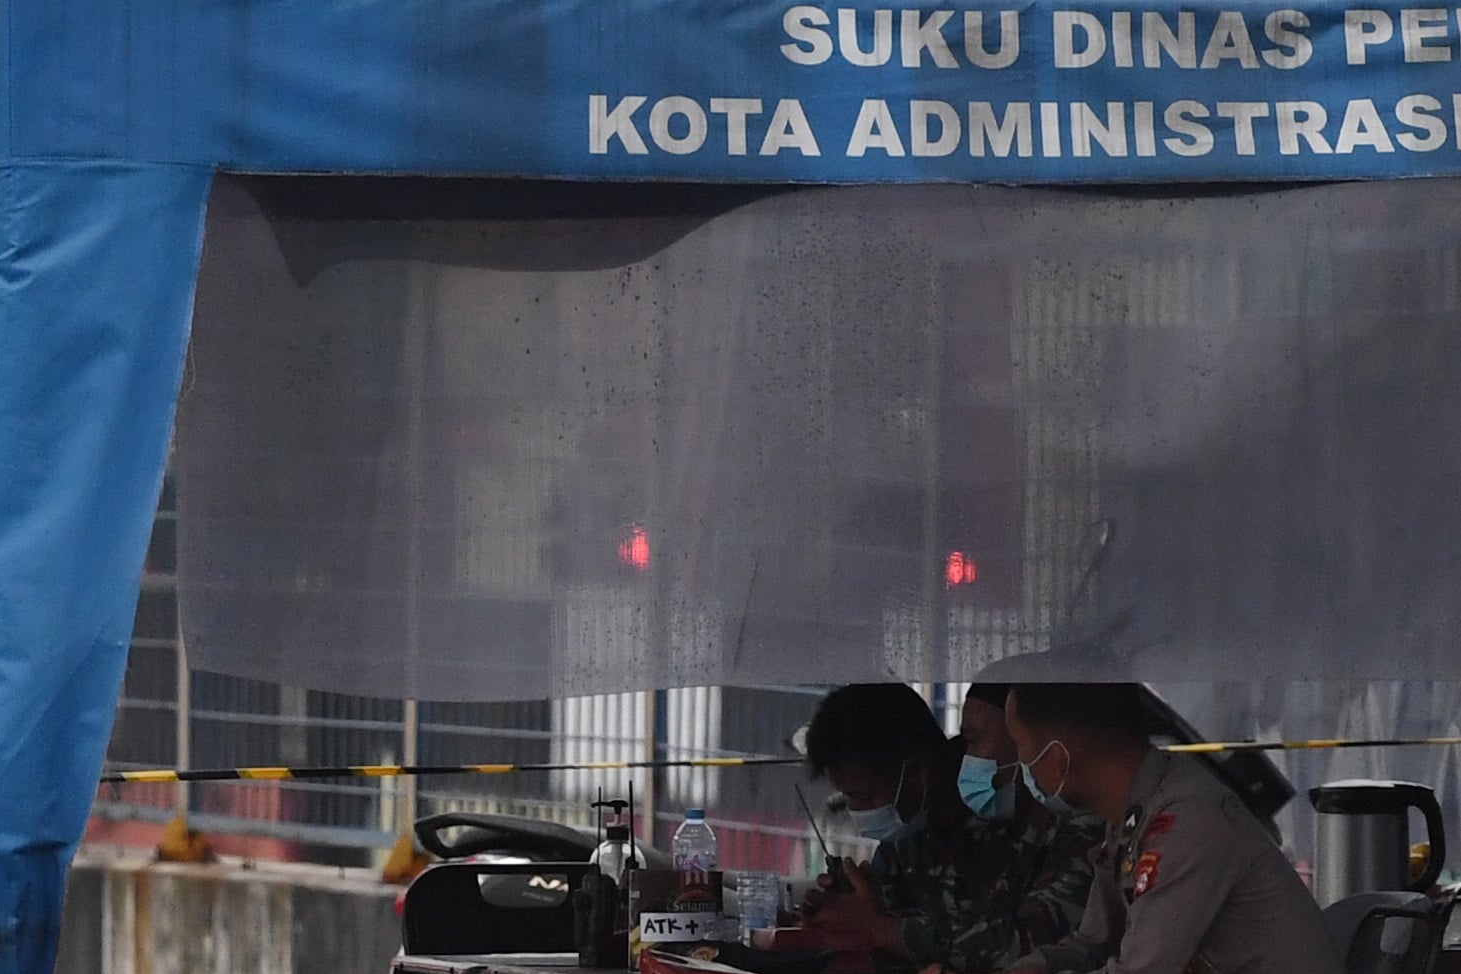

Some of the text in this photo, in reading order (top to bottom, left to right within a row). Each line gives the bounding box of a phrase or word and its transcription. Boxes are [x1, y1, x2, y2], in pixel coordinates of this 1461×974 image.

[780, 5, 1461, 70] SUKU DINAS PE
[589, 94, 820, 155] KOTA
